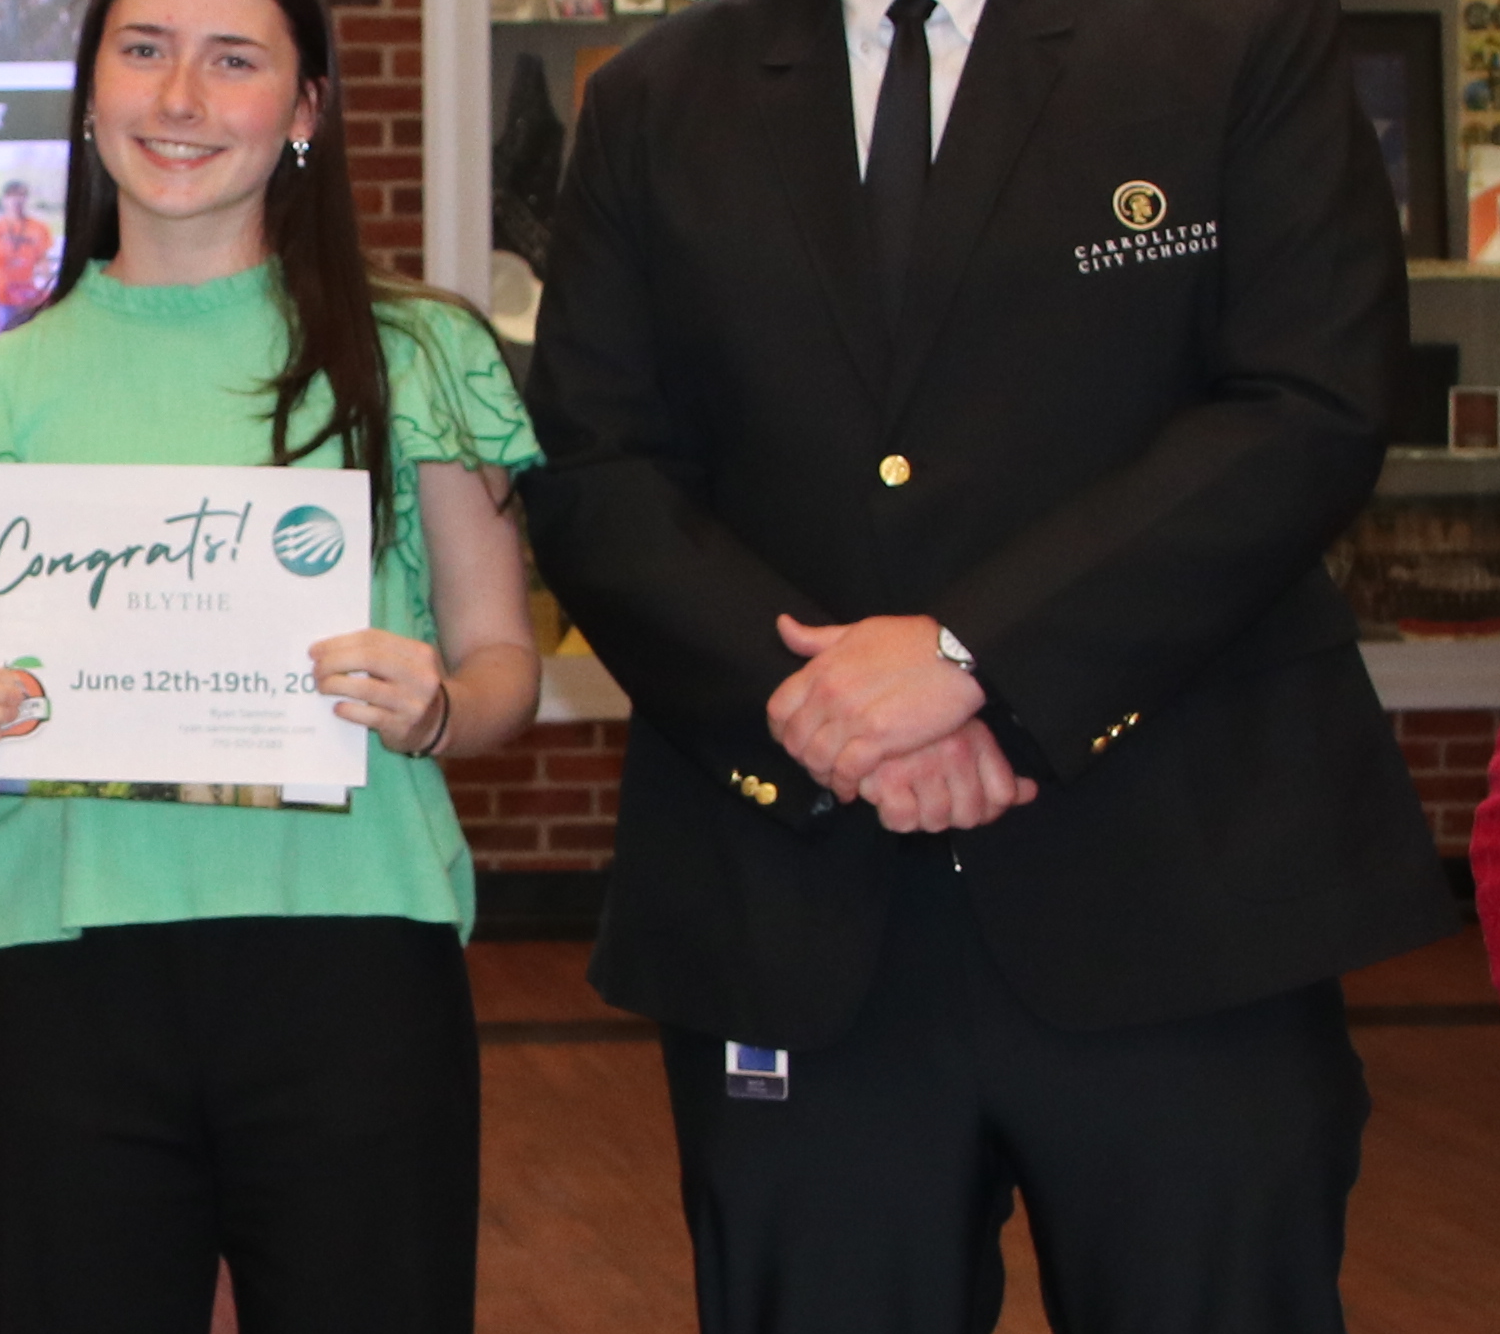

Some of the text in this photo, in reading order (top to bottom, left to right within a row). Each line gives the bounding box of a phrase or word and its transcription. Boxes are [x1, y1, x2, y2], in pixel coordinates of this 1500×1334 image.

[1074, 220, 1217, 259] CARROLLTON
[1078, 235, 1218, 275] CITY SCHOOLS
[127, 591, 231, 612] BLYTHE
[70, 669, 317, 695] June 12th-19th, 20
